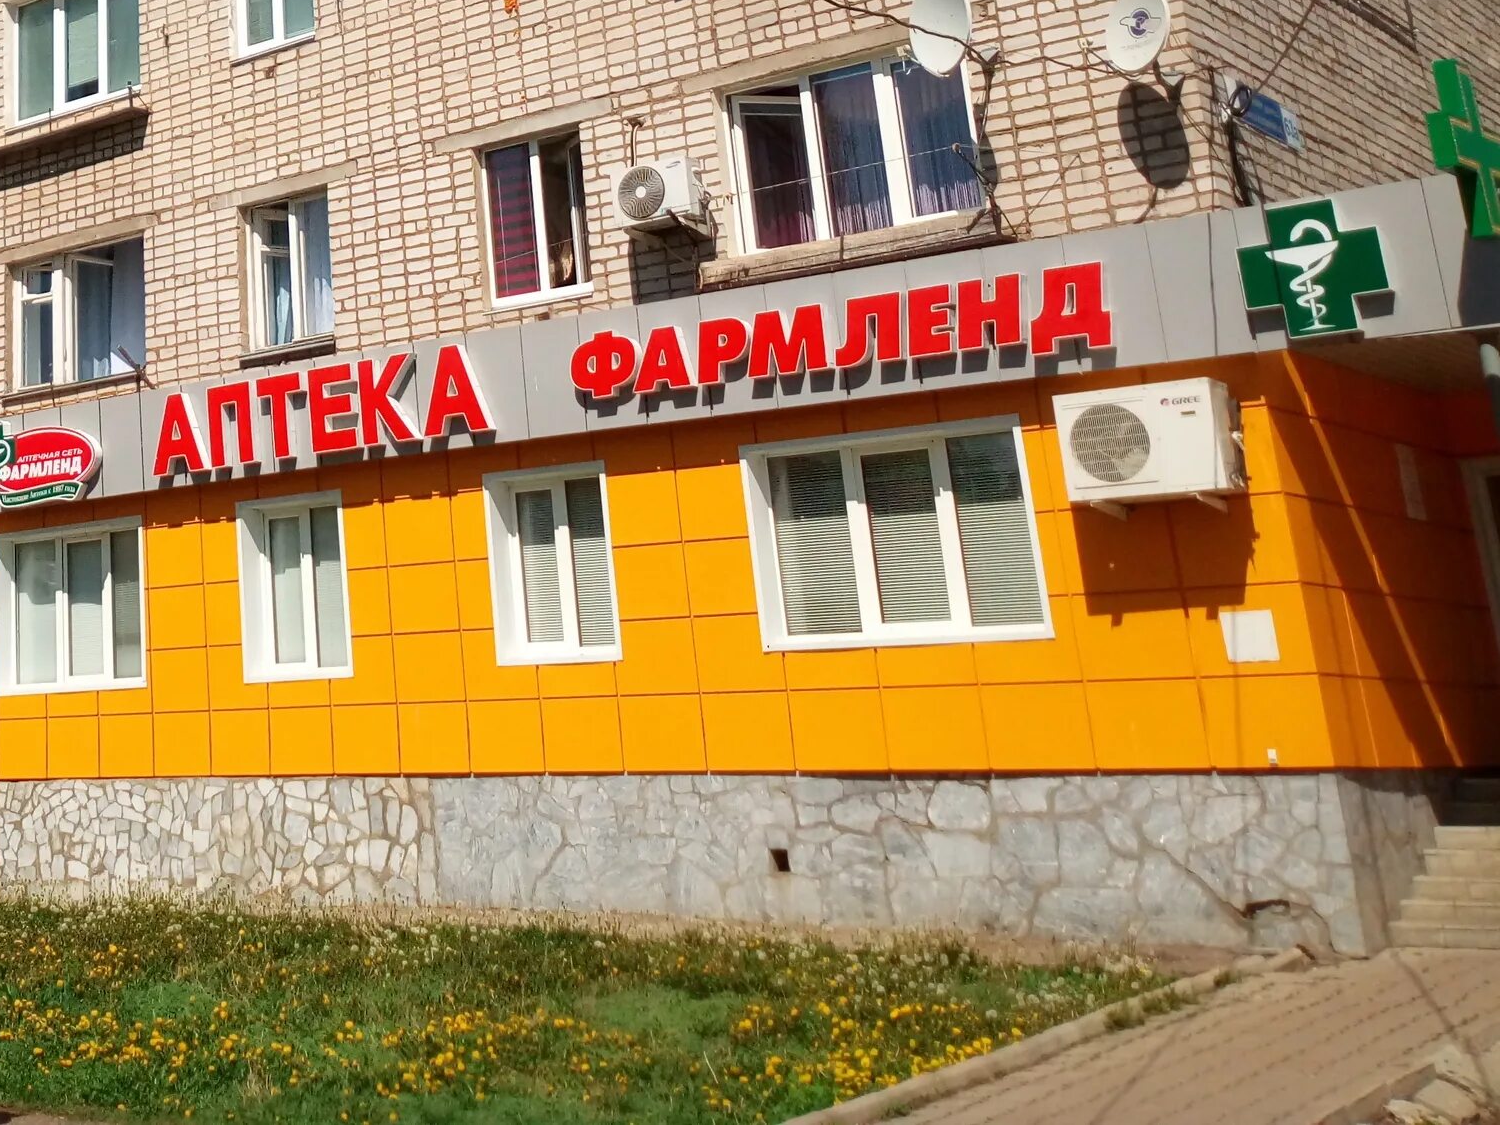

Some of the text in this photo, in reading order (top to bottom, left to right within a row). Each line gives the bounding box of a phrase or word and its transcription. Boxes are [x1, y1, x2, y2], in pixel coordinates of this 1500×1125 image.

[153, 261, 1112, 475] АПТЕКА ФАРМЛЕНД
[1172, 396, 1200, 405] GREE
[17, 447, 83, 463] АПТЕЧНАЯ СЕТЬ
[0, 456, 82, 481] ФАРМЛЕНД
